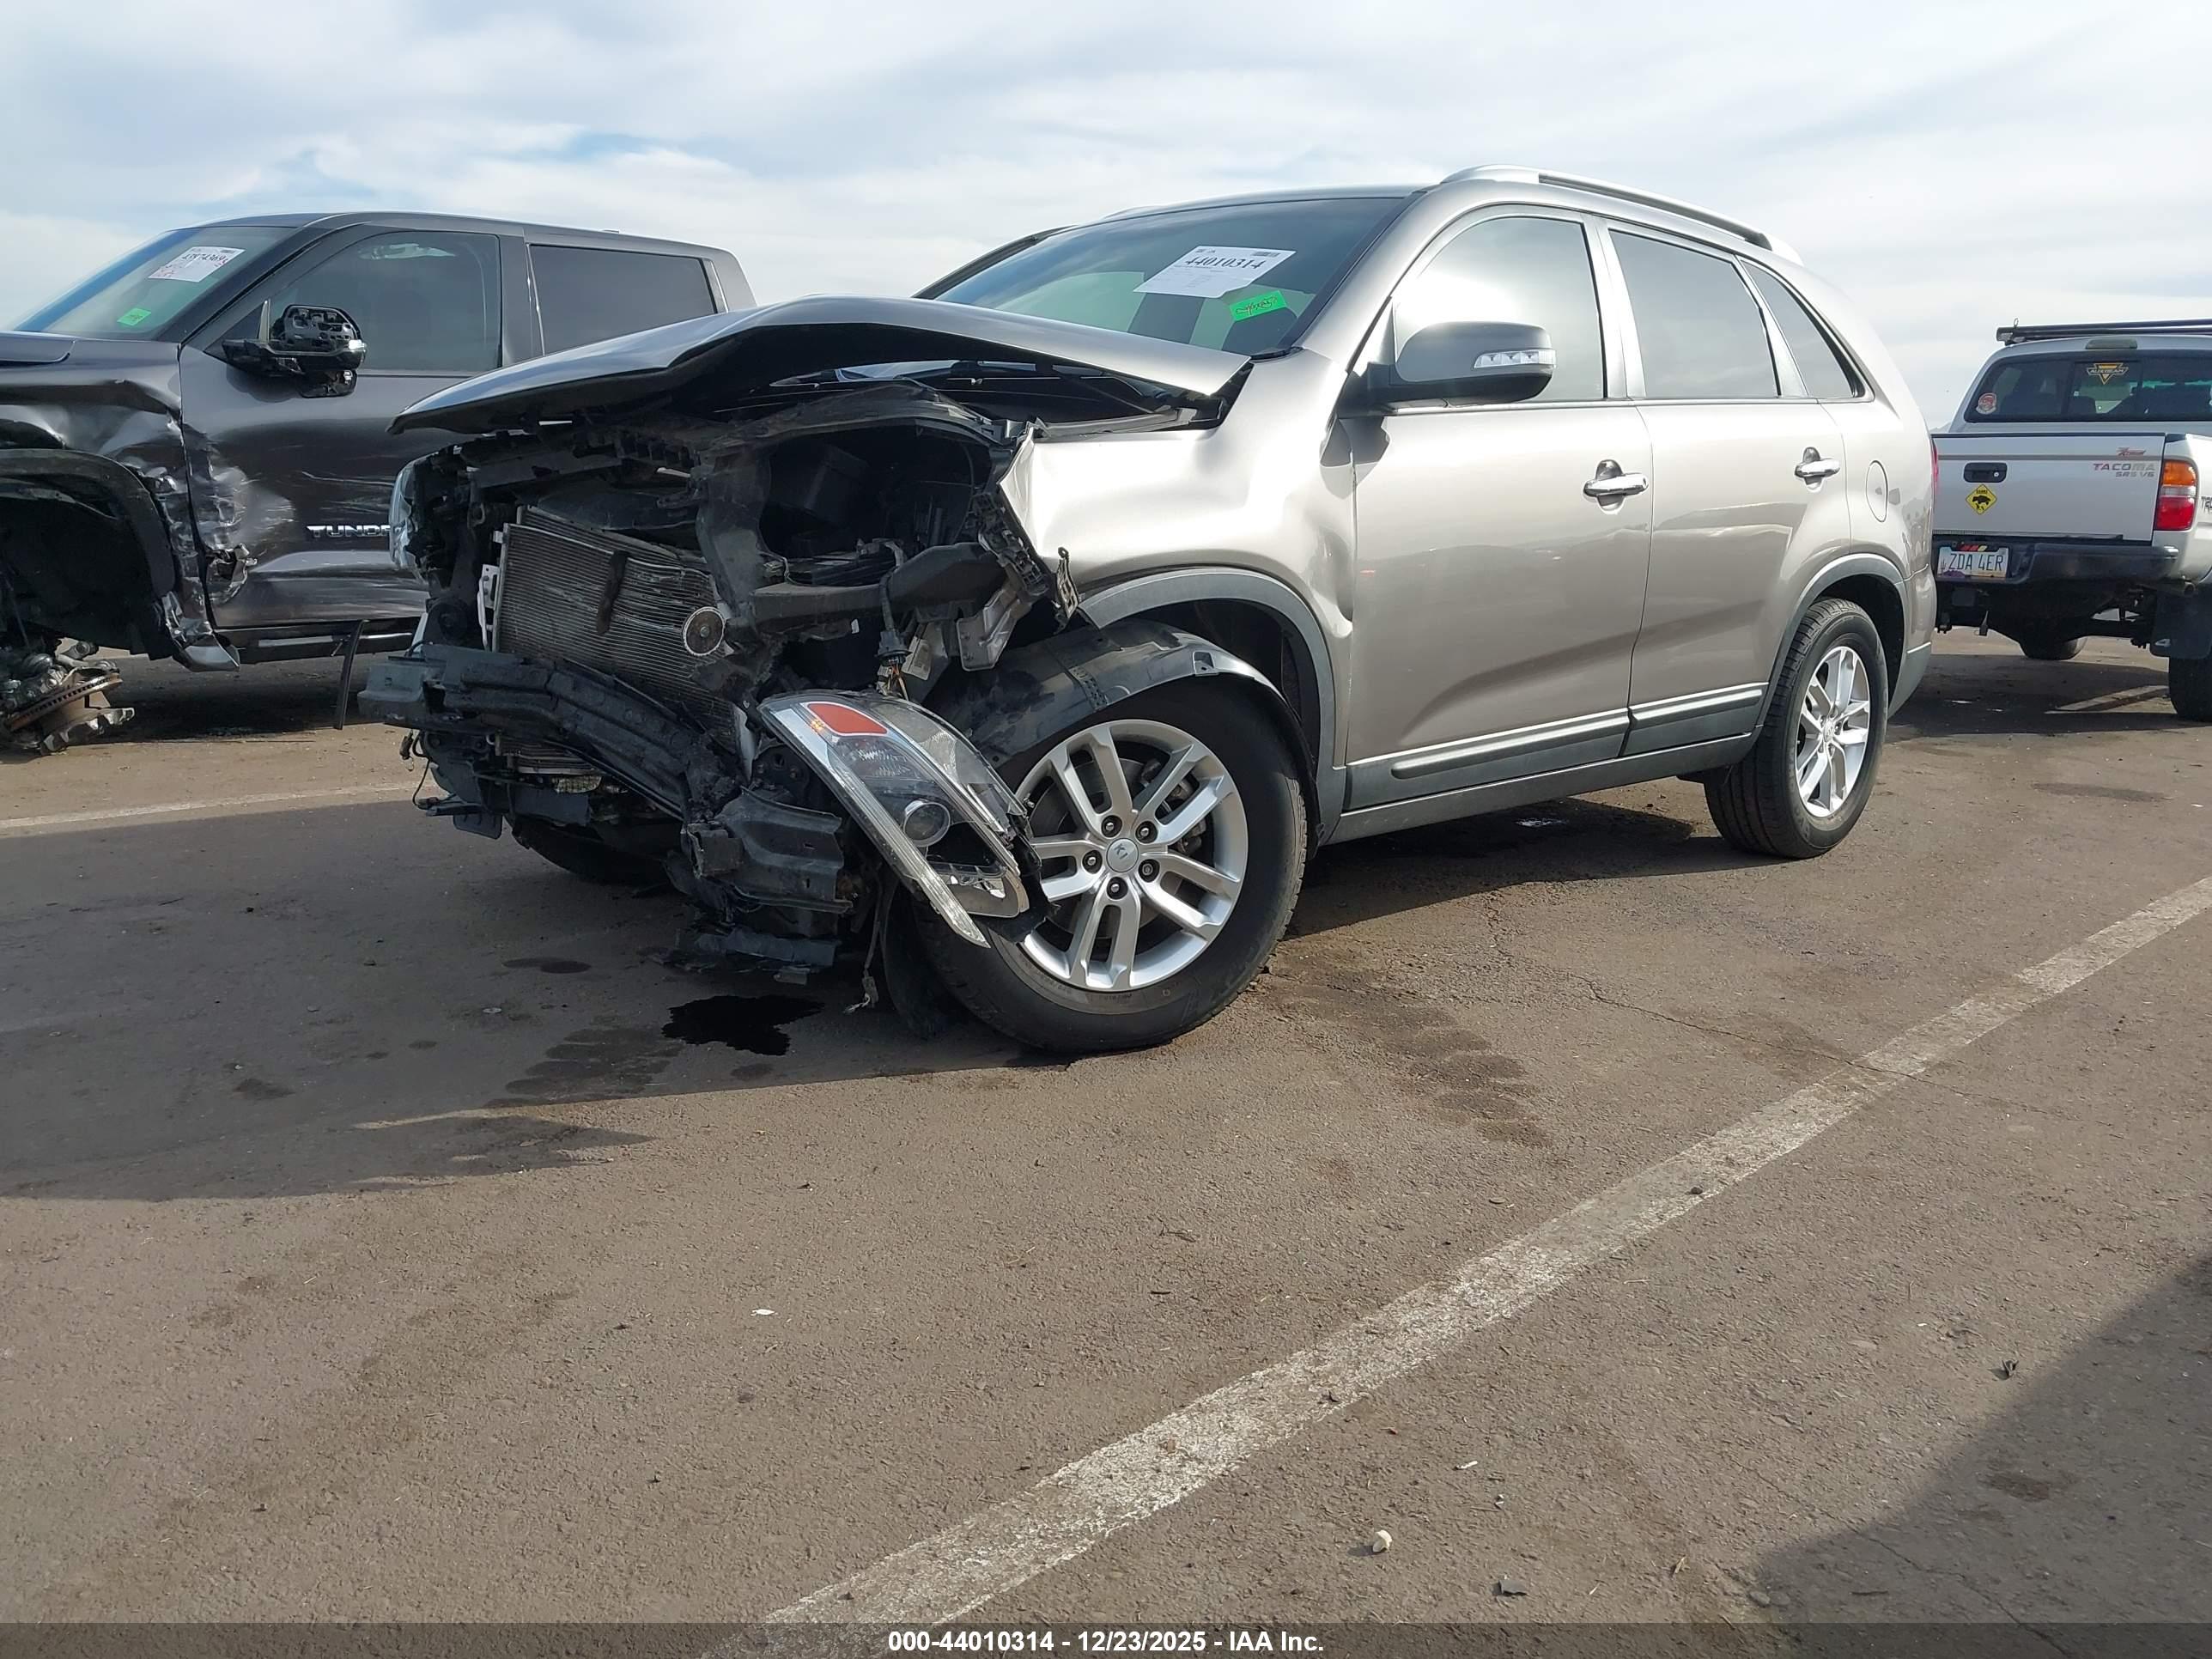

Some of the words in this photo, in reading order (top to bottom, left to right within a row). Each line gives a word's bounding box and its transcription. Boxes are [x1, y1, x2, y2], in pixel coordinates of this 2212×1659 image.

[1186, 257, 1266, 269] 44010314
[307, 525, 392, 538] TUNDR
[1948, 553, 1973, 570] ZDA
[1978, 554, 2003, 571] 4ER
